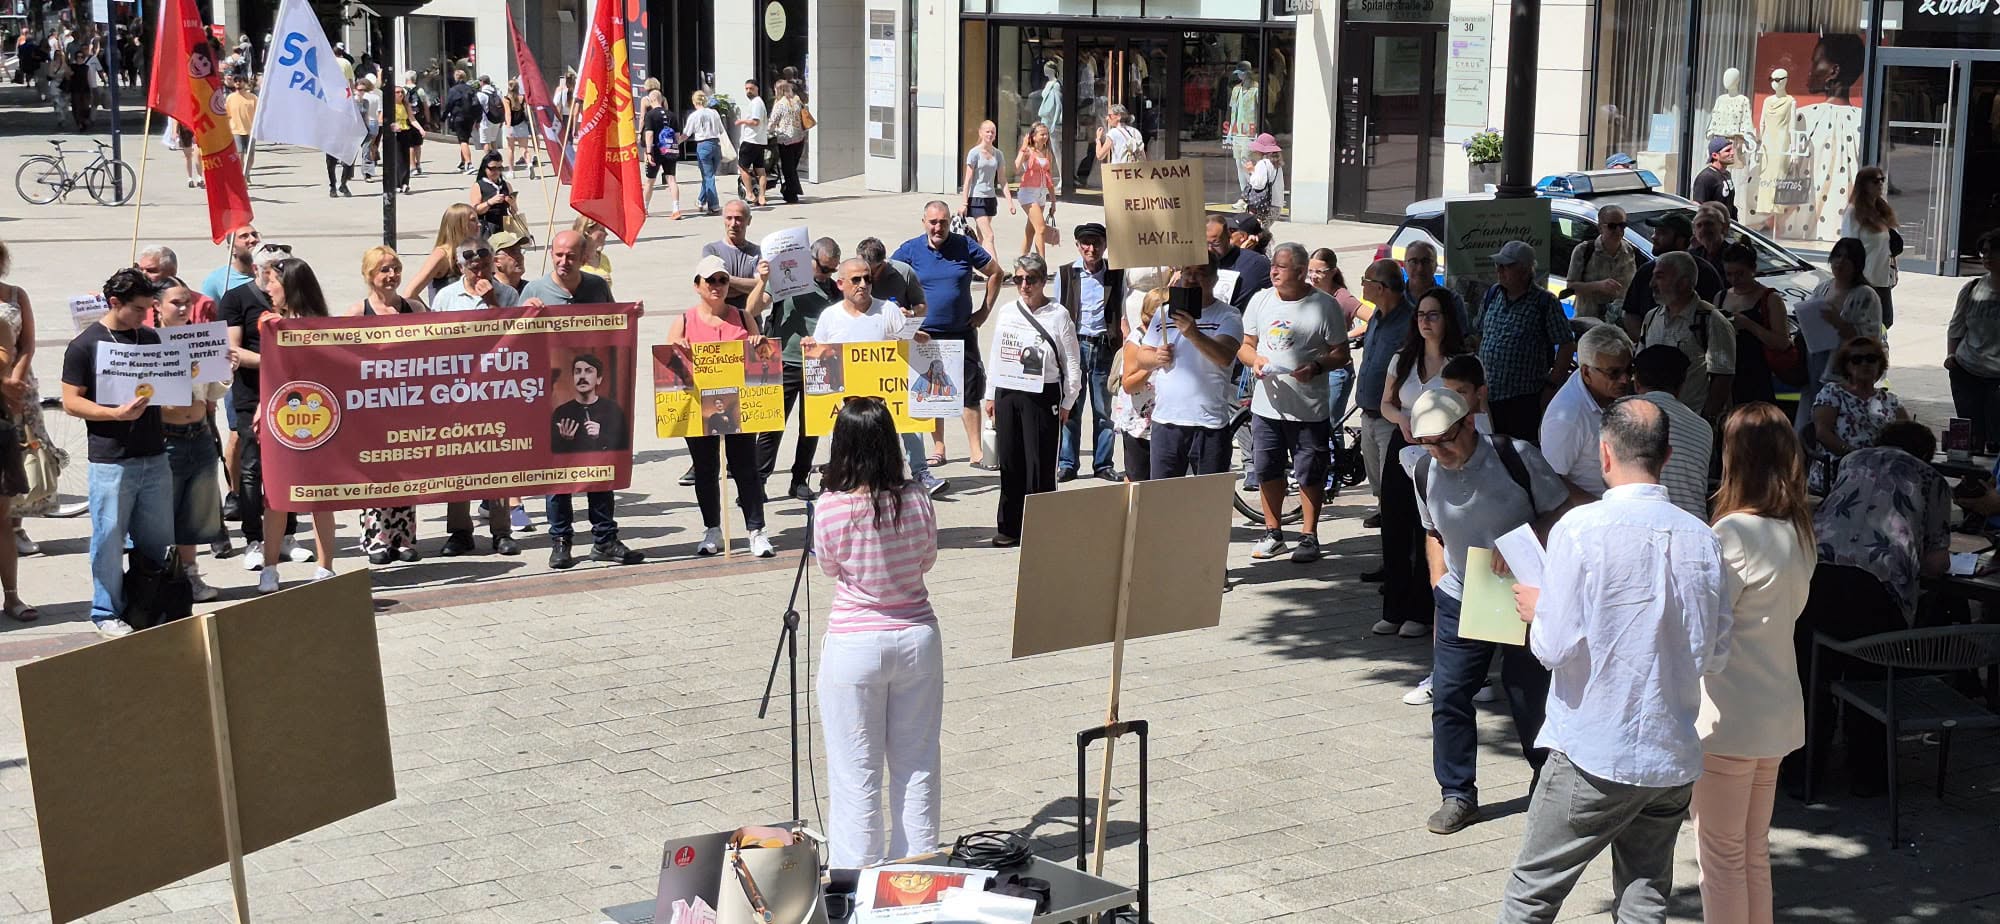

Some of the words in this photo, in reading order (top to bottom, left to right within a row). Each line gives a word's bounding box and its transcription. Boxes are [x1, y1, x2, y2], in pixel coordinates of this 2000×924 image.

[1464, 22, 1474, 32] 30
[1222, 120, 1257, 135] SALE
[1111, 168, 1144, 180] TEK
[1150, 164, 1191, 180] ADAM
[169, 332, 195, 342] HOCH
[196, 330, 210, 338] DIE
[281, 331, 330, 345] Finger
[333, 330, 362, 344] weg
[365, 329, 391, 340] von
[395, 326, 420, 338] der
[424, 322, 472, 336] Kunst-
[474, 320, 499, 332] und
[502, 315, 624, 331] Meinungsfreiheit!
[109, 349, 141, 359] Finger
[142, 350, 162, 359] weg
[164, 349, 180, 357] von
[110, 359, 127, 367] der
[129, 359, 161, 368] Kunst-
[163, 359, 180, 367] und
[360, 354, 474, 380] FREIHEIT
[480, 347, 529, 373] FÜR
[102, 367, 187, 380] Meinungsfreiheit!
[346, 381, 425, 410] DENİZ
[430, 377, 545, 405] GÖKTAŞ!
[286, 413, 321, 426] DIDF
[387, 425, 436, 444] DENİZ
[439, 421, 506, 440] GÖKTAŞ
[359, 446, 433, 463] SERBEST
[435, 437, 533, 458] BIRAKILSIN!
[295, 486, 339, 499] Sanat
[343, 487, 361, 496] ve
[364, 482, 400, 496] ifade
[403, 473, 508, 494] özgürlüğünden
[511, 467, 568, 483] ellerinizi
[570, 466, 612, 482] çekin!
